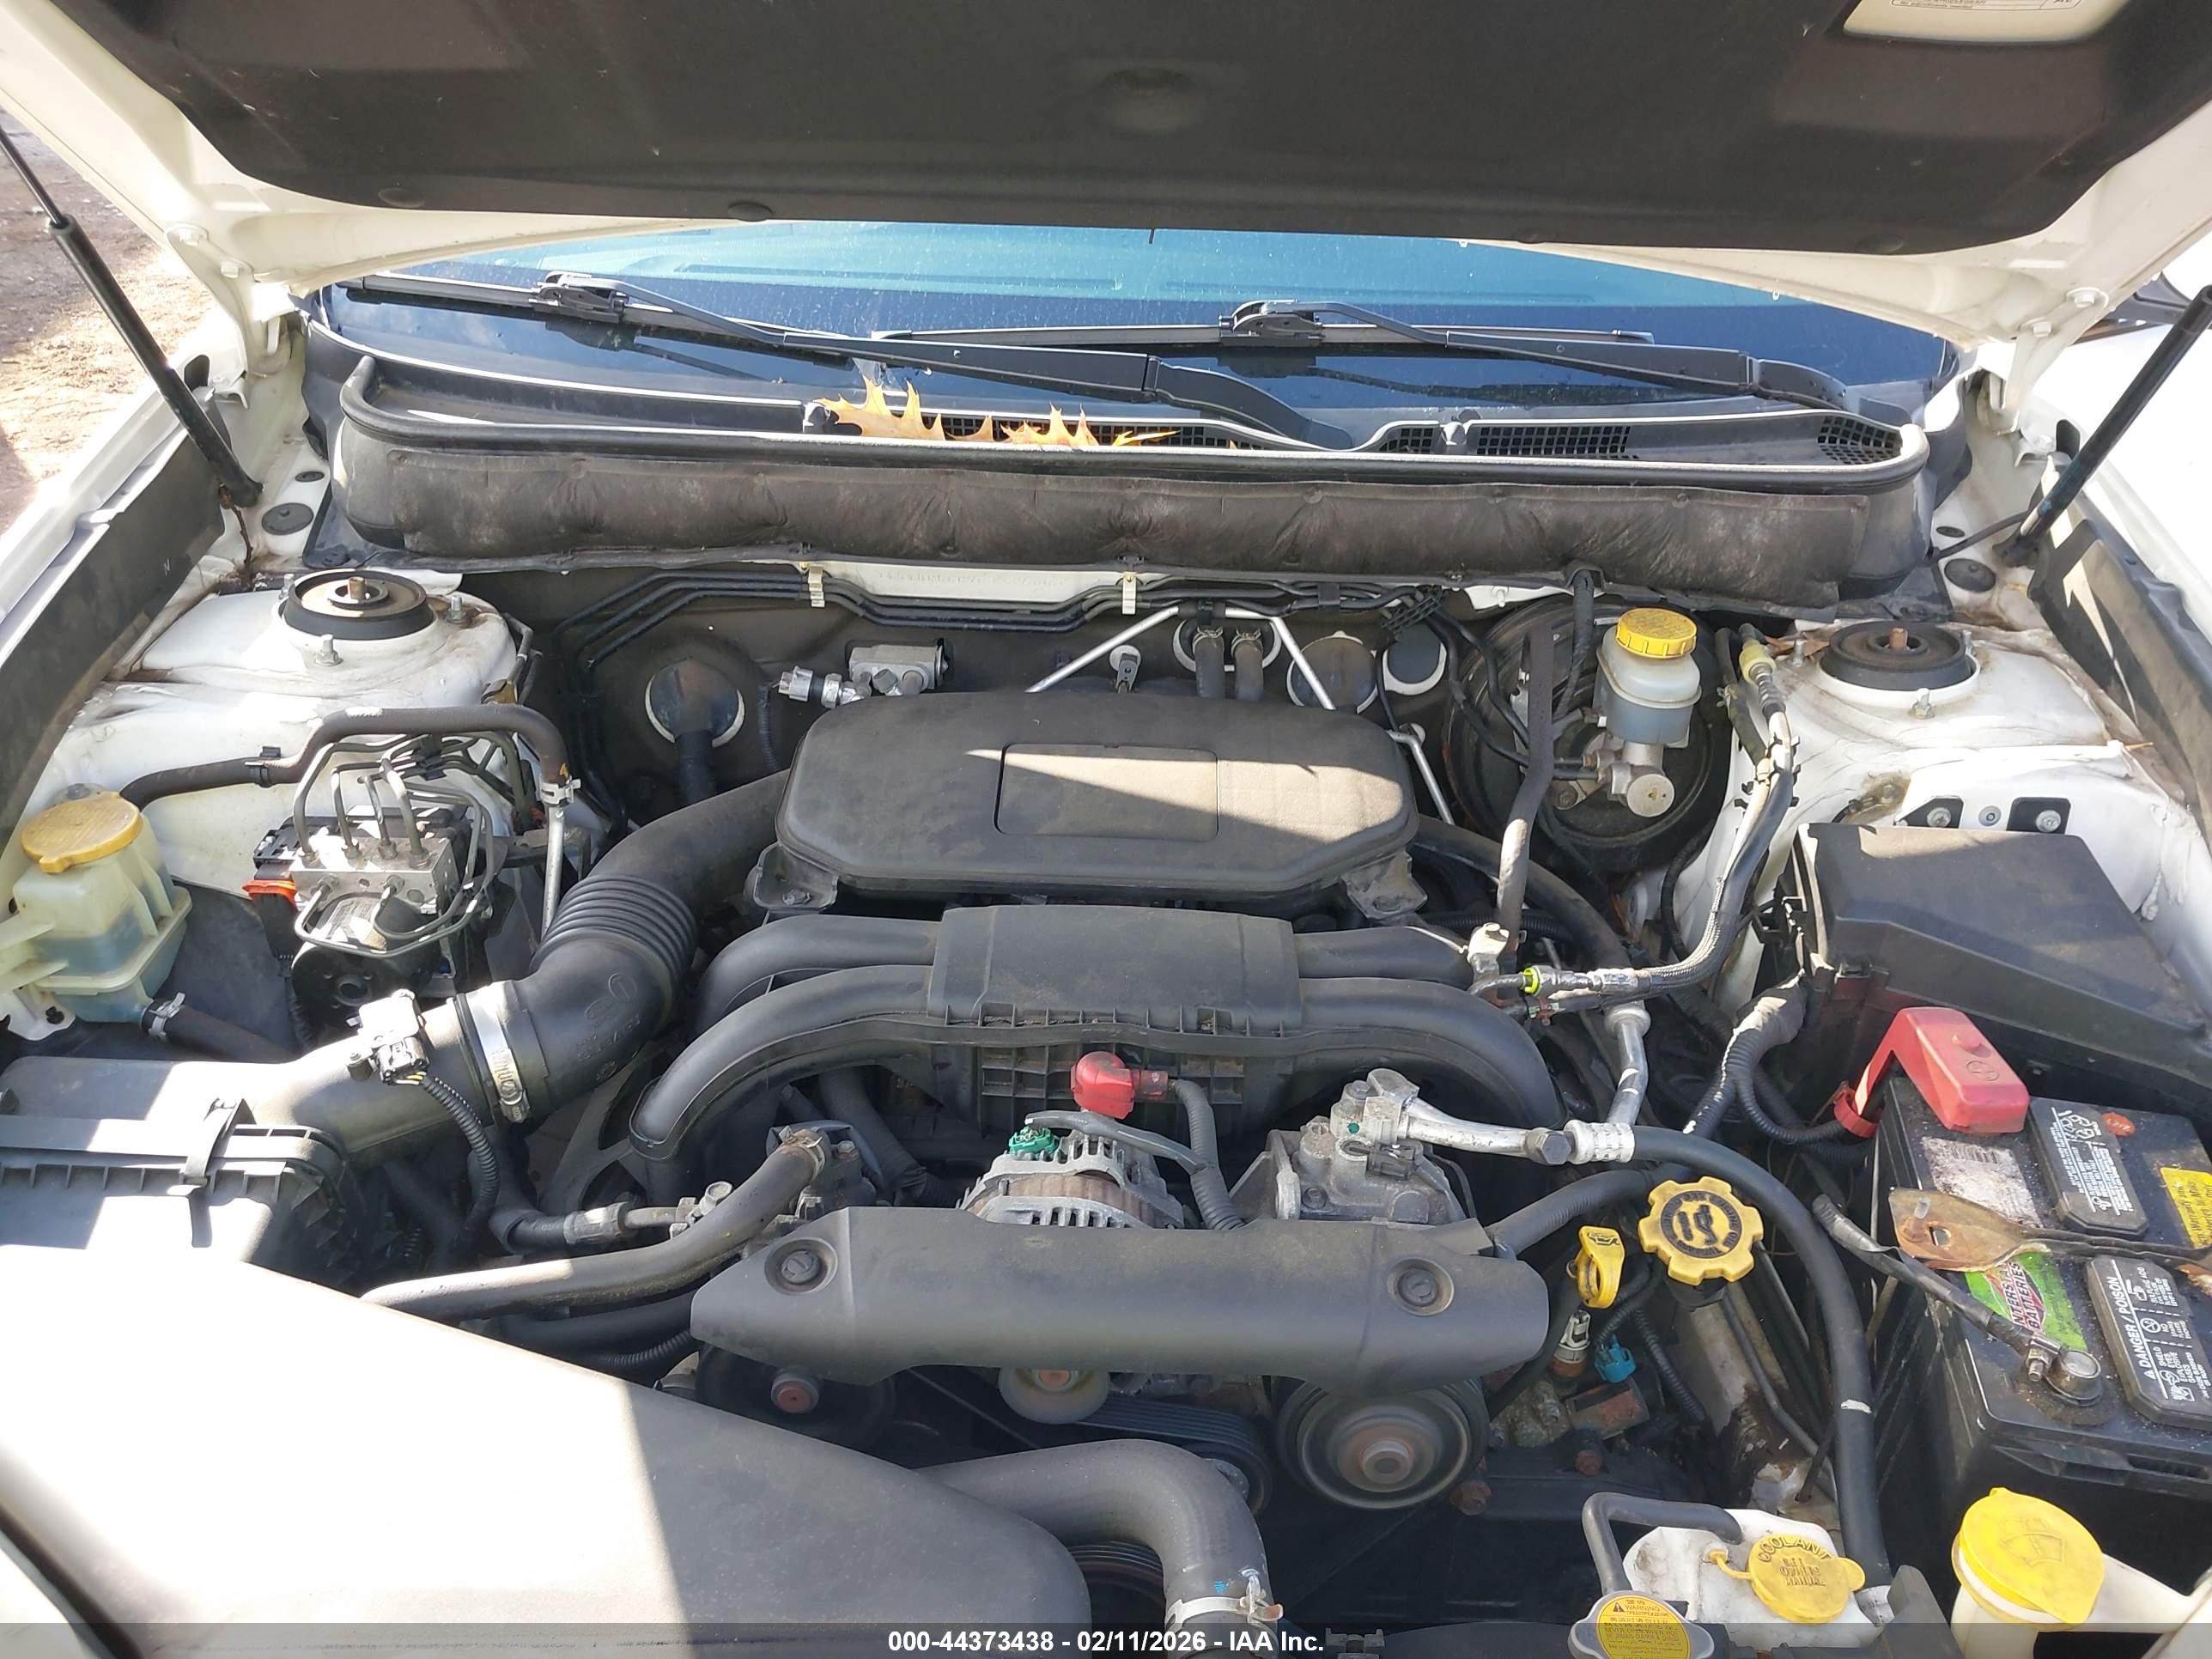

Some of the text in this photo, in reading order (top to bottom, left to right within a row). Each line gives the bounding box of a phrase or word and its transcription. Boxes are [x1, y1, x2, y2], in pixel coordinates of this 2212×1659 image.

[2010, 1262, 2040, 1330] BATTERIES
[2106, 1276, 2131, 1314] POISON
[2160, 1323, 2169, 1332] NO
[2125, 1323, 2152, 1369] DANGER
[2153, 1347, 2167, 1367] SHIELD
[2163, 1352, 2175, 1367] EYES
[1758, 1536, 1832, 1563] COOLANT
